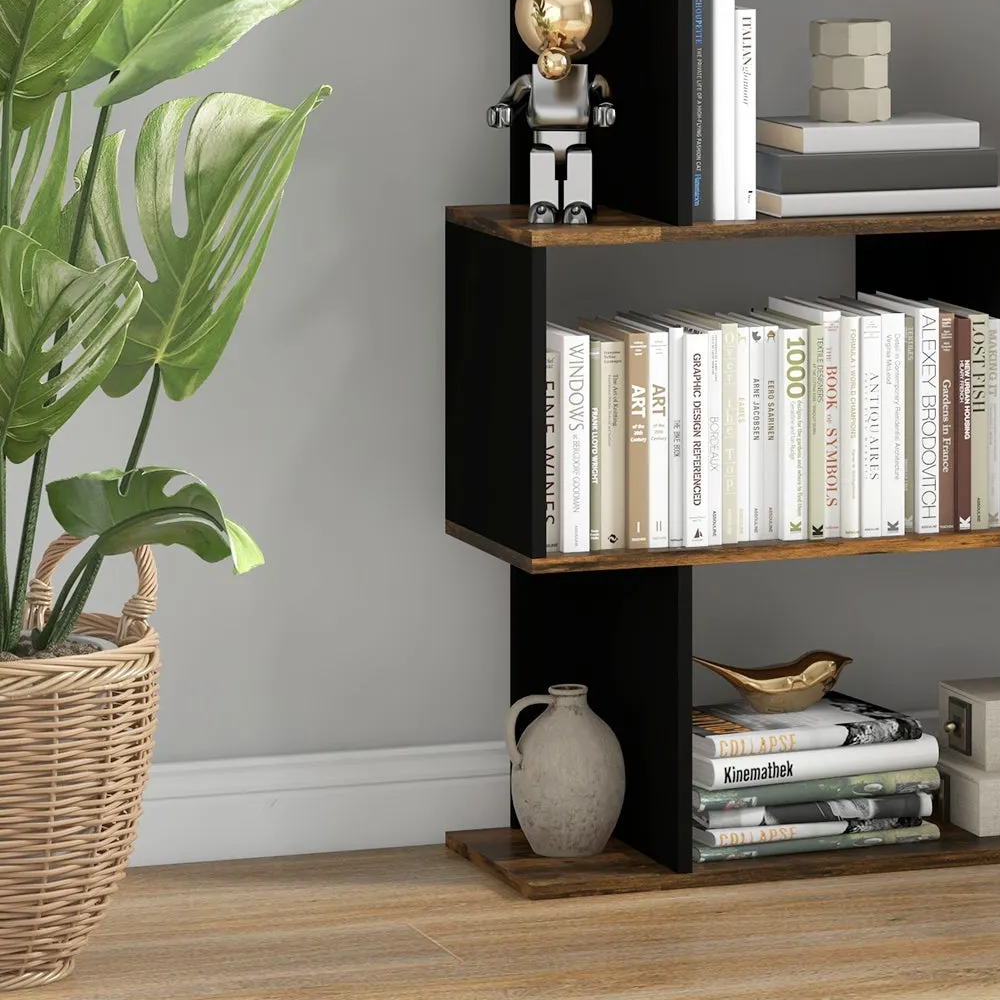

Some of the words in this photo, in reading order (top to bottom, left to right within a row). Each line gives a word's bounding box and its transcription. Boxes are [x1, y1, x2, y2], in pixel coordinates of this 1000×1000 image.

[742, 16, 752, 65] ITALIAN
[922, 315, 936, 388] ALEXEY
[972, 321, 985, 368] LOST
[989, 329, 997, 381] MAKING
[568, 343, 584, 431] WINDOWS
[693, 353, 702, 398] GRAPHIC
[786, 337, 806, 398] 1000
[826, 365, 837, 410] BOOK
[631, 385, 645, 418] ART
[652, 384, 665, 416] ART
[942, 379, 950, 422] Gardens
[972, 373, 985, 412] FISH
[989, 384, 997, 397] IT
[693, 401, 702, 437] DESIGN
[867, 372, 879, 480] ANTIQUAIRES
[942, 425, 950, 435] in
[710, 417, 720, 471] BORDEAUX
[922, 395, 936, 519] BRODOVITCH
[942, 438, 950, 472] France
[693, 440, 702, 506] REFERENCED
[826, 428, 838, 507] SYMBOLS
[719, 733, 795, 757] COLLAPSE
[724, 761, 793, 784] Kinemathek
[719, 826, 796, 847] COLLAPSE
